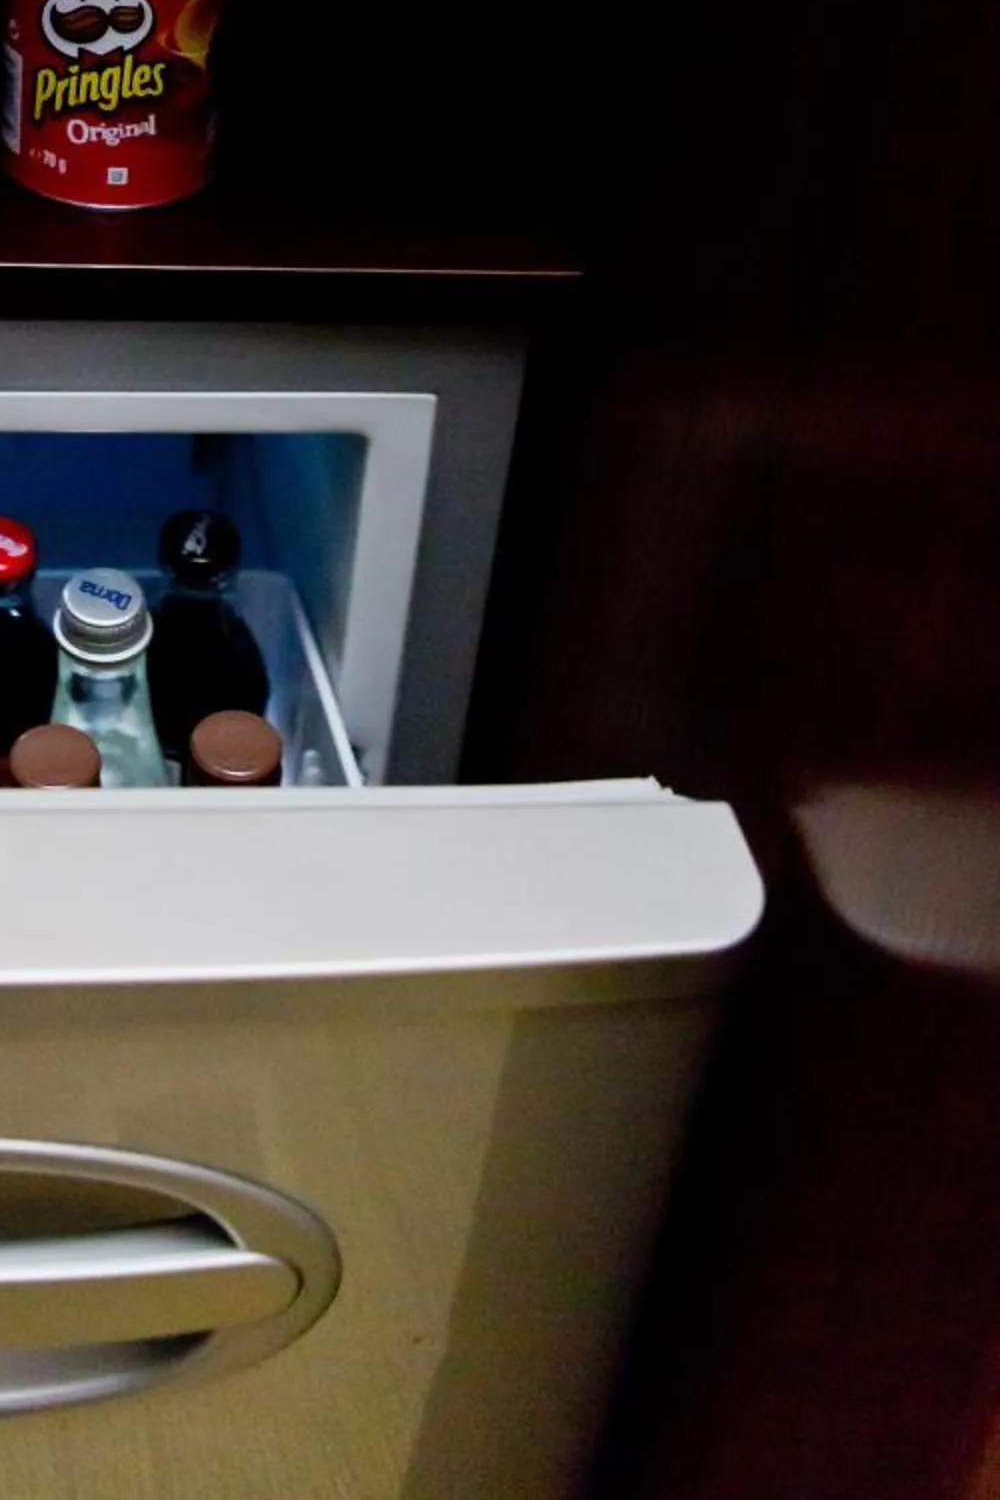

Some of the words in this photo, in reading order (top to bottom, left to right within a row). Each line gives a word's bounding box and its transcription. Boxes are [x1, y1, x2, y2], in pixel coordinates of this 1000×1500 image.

[33, 53, 167, 121] Pringles
[66, 113, 158, 147] Original
[79, 580, 133, 611] Dorna
